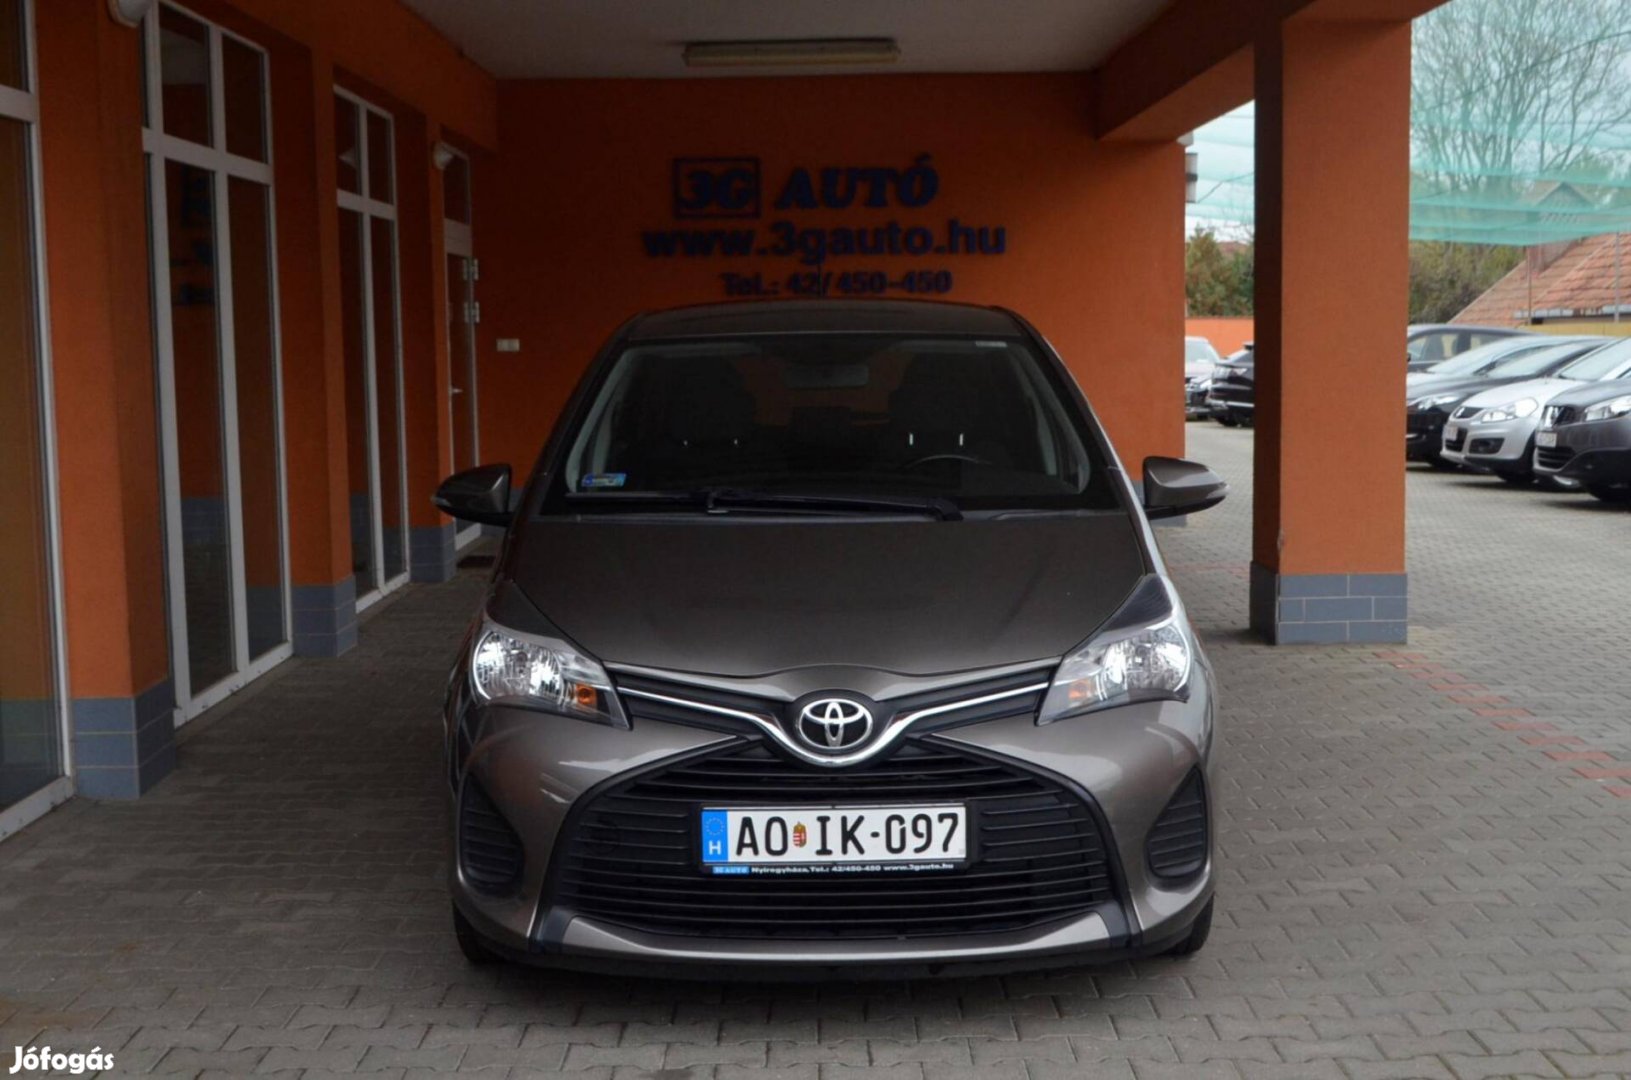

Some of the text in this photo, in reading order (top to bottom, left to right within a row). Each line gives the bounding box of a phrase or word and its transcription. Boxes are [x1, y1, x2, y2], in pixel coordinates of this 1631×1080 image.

[679, 153, 939, 209] 3G AUTÓ
[641, 219, 1006, 265] www.3gauto.hu
[720, 272, 779, 295] Tel.:
[708, 840, 721, 855] H
[736, 816, 788, 856] AO
[883, 863, 954, 871] www.3gauto.hu
